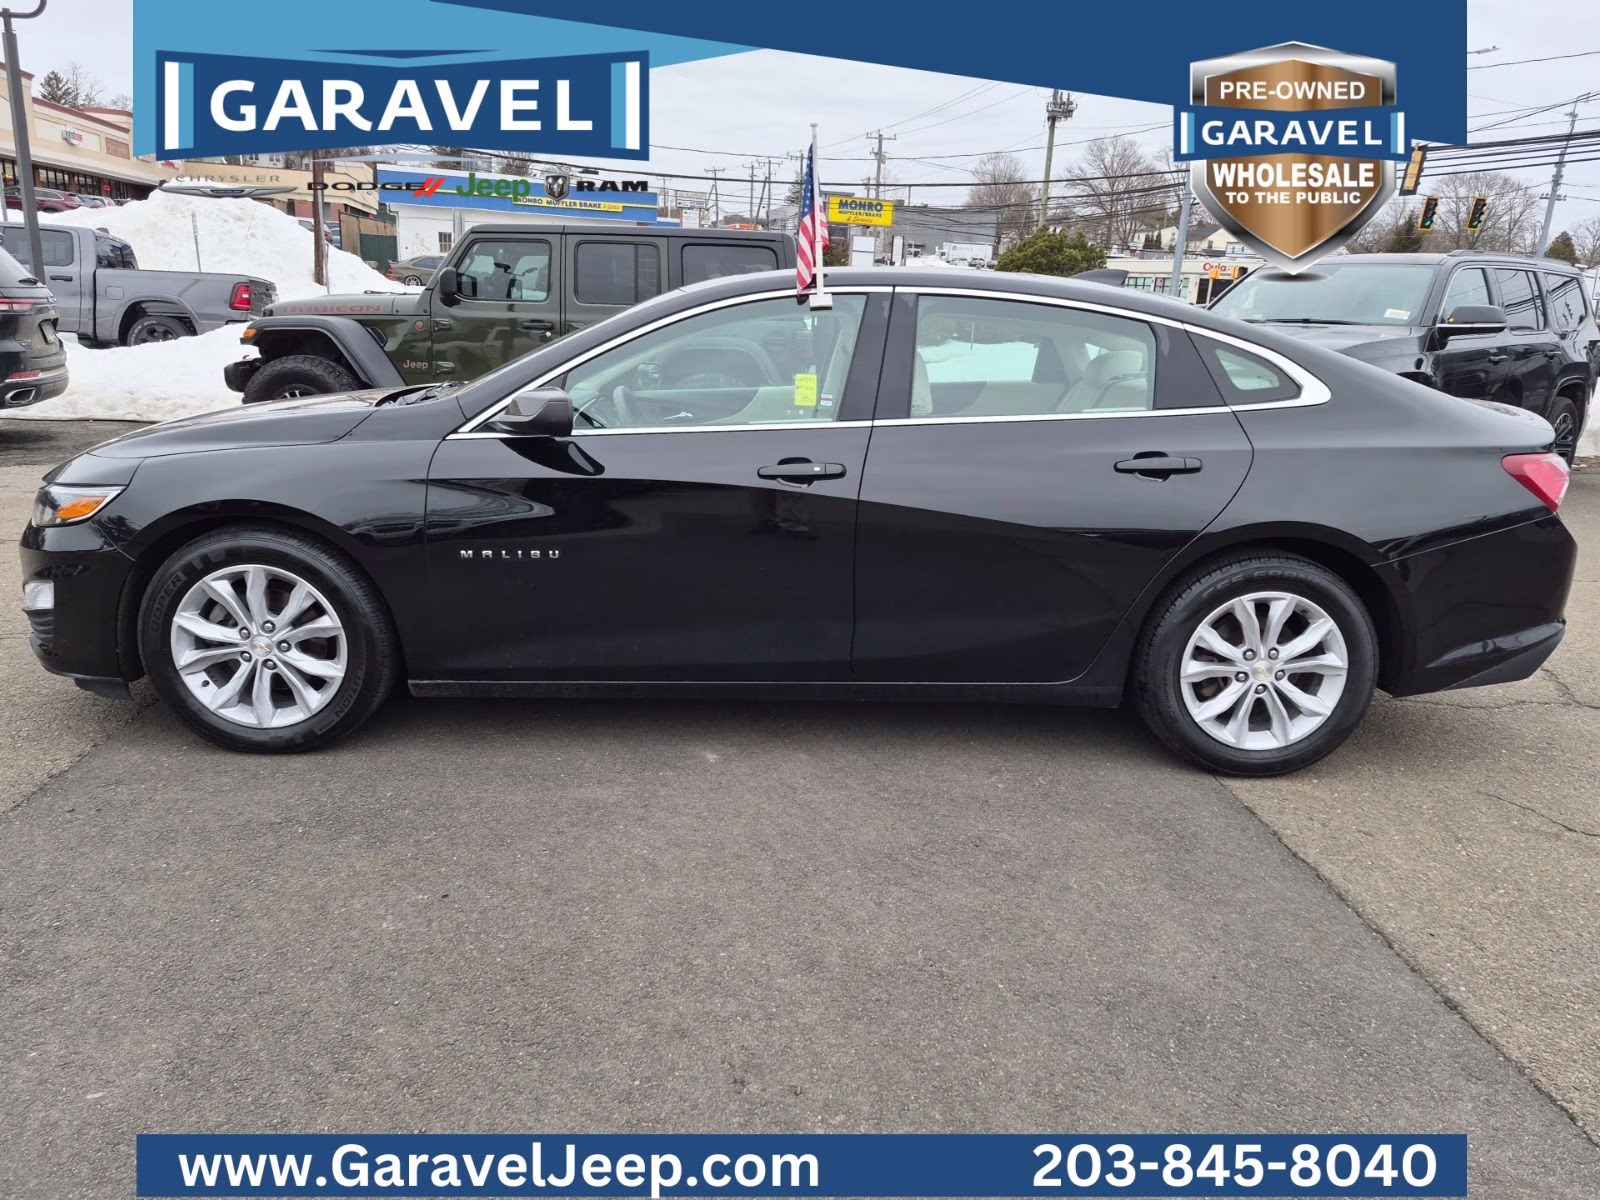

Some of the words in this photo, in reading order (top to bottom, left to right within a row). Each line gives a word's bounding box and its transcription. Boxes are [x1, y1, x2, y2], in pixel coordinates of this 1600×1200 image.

[517, 197, 543, 205] ONRO
[545, 199, 578, 208] MUFFLER
[579, 202, 602, 210] BRAKE
[838, 198, 884, 213] MONRO
[282, 304, 382, 314] RUBICON
[403, 359, 429, 371] Jeep
[459, 549, 561, 560] MALIBU
